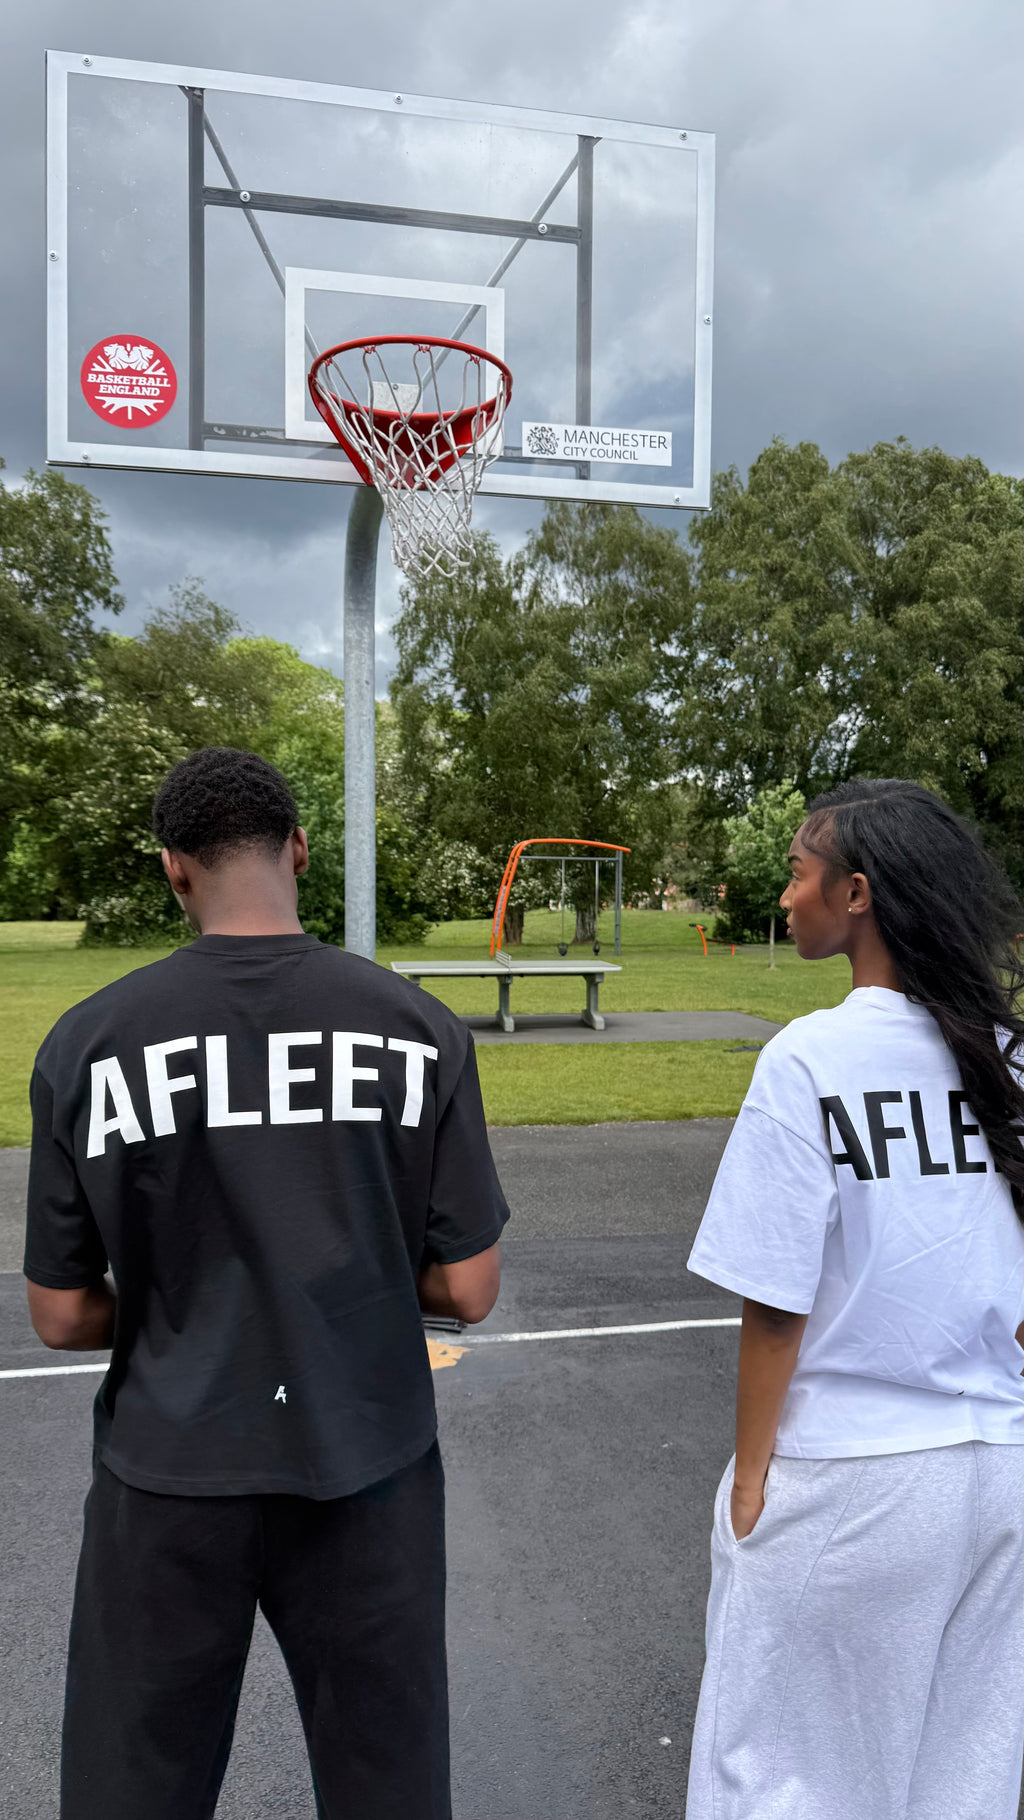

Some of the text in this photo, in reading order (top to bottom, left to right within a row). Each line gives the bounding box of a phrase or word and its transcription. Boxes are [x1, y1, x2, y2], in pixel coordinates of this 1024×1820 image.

[87, 373, 171, 387] BASKETBALL
[99, 384, 160, 396] ENGLAND
[564, 429, 668, 449] MANCHESTER
[563, 446, 638, 461] CITY COUNCIL
[87, 1031, 438, 1159] AFLEET
[819, 1090, 1022, 1181] AFLE
